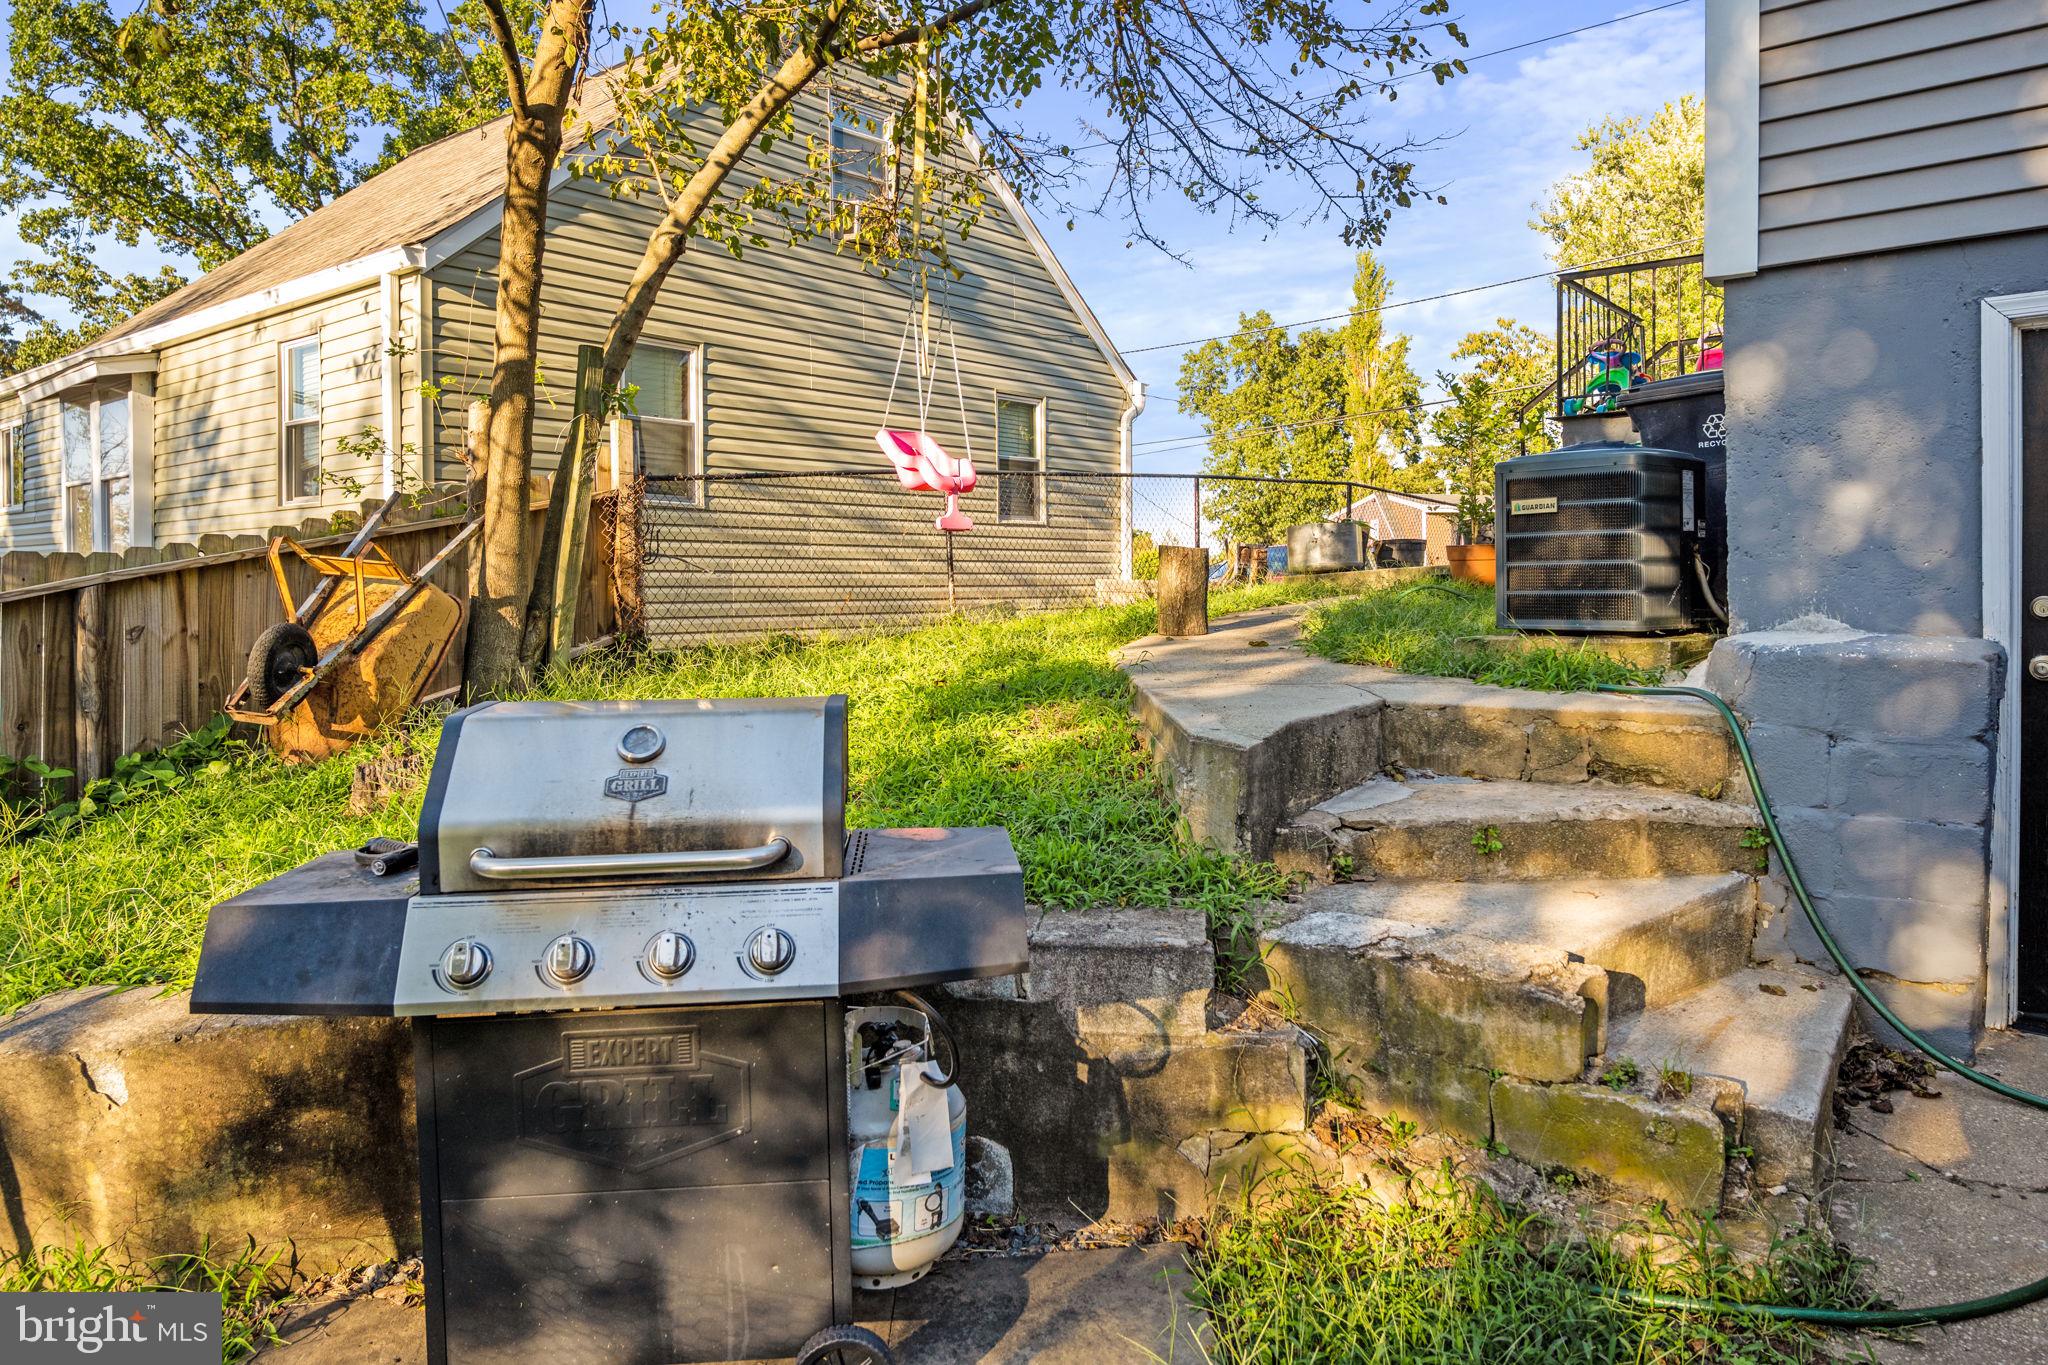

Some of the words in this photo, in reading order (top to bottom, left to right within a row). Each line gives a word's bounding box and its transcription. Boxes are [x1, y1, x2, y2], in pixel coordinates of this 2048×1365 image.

[1521, 502, 1556, 511] GUARDIAN
[610, 779, 661, 792] GRILL
[587, 1036, 674, 1067] EXPERT
[536, 1074, 729, 1134] GRILL
